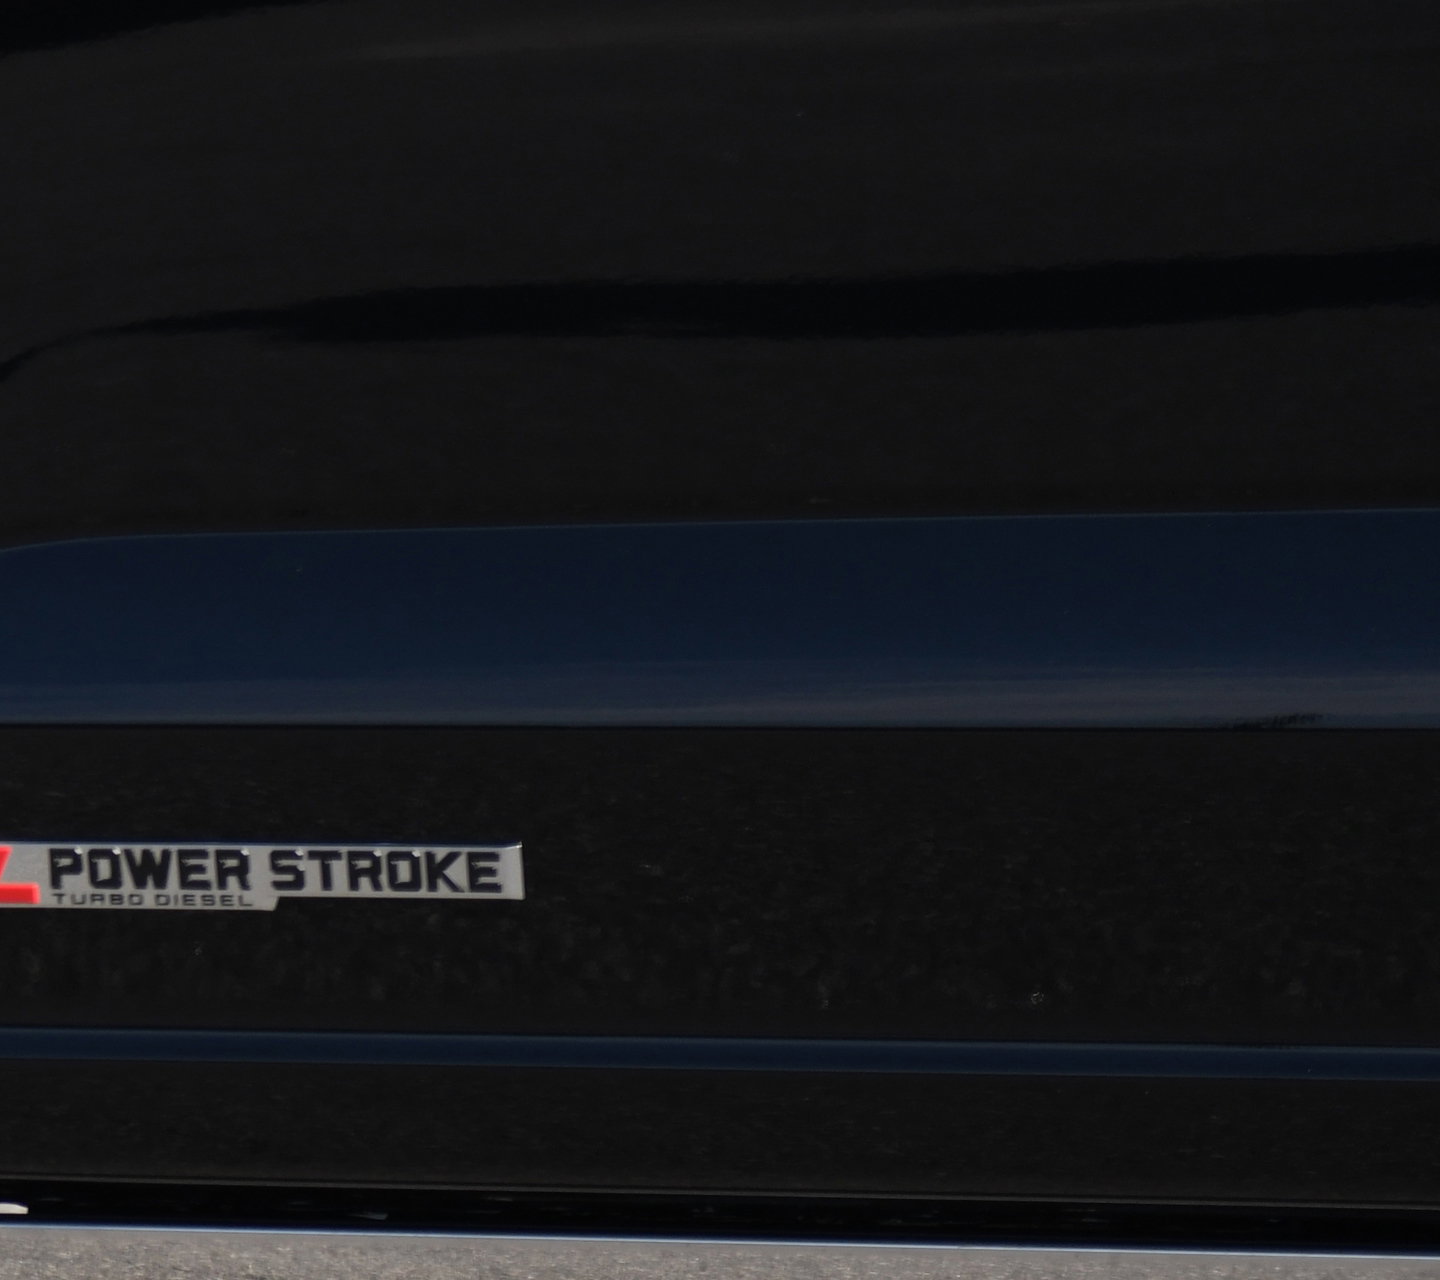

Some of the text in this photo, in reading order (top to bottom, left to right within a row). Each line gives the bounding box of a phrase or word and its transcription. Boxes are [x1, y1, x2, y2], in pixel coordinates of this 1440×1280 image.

[47, 846, 253, 893] POWER
[269, 846, 504, 895] STROKE
[52, 891, 255, 910] TURBO DIESEL
